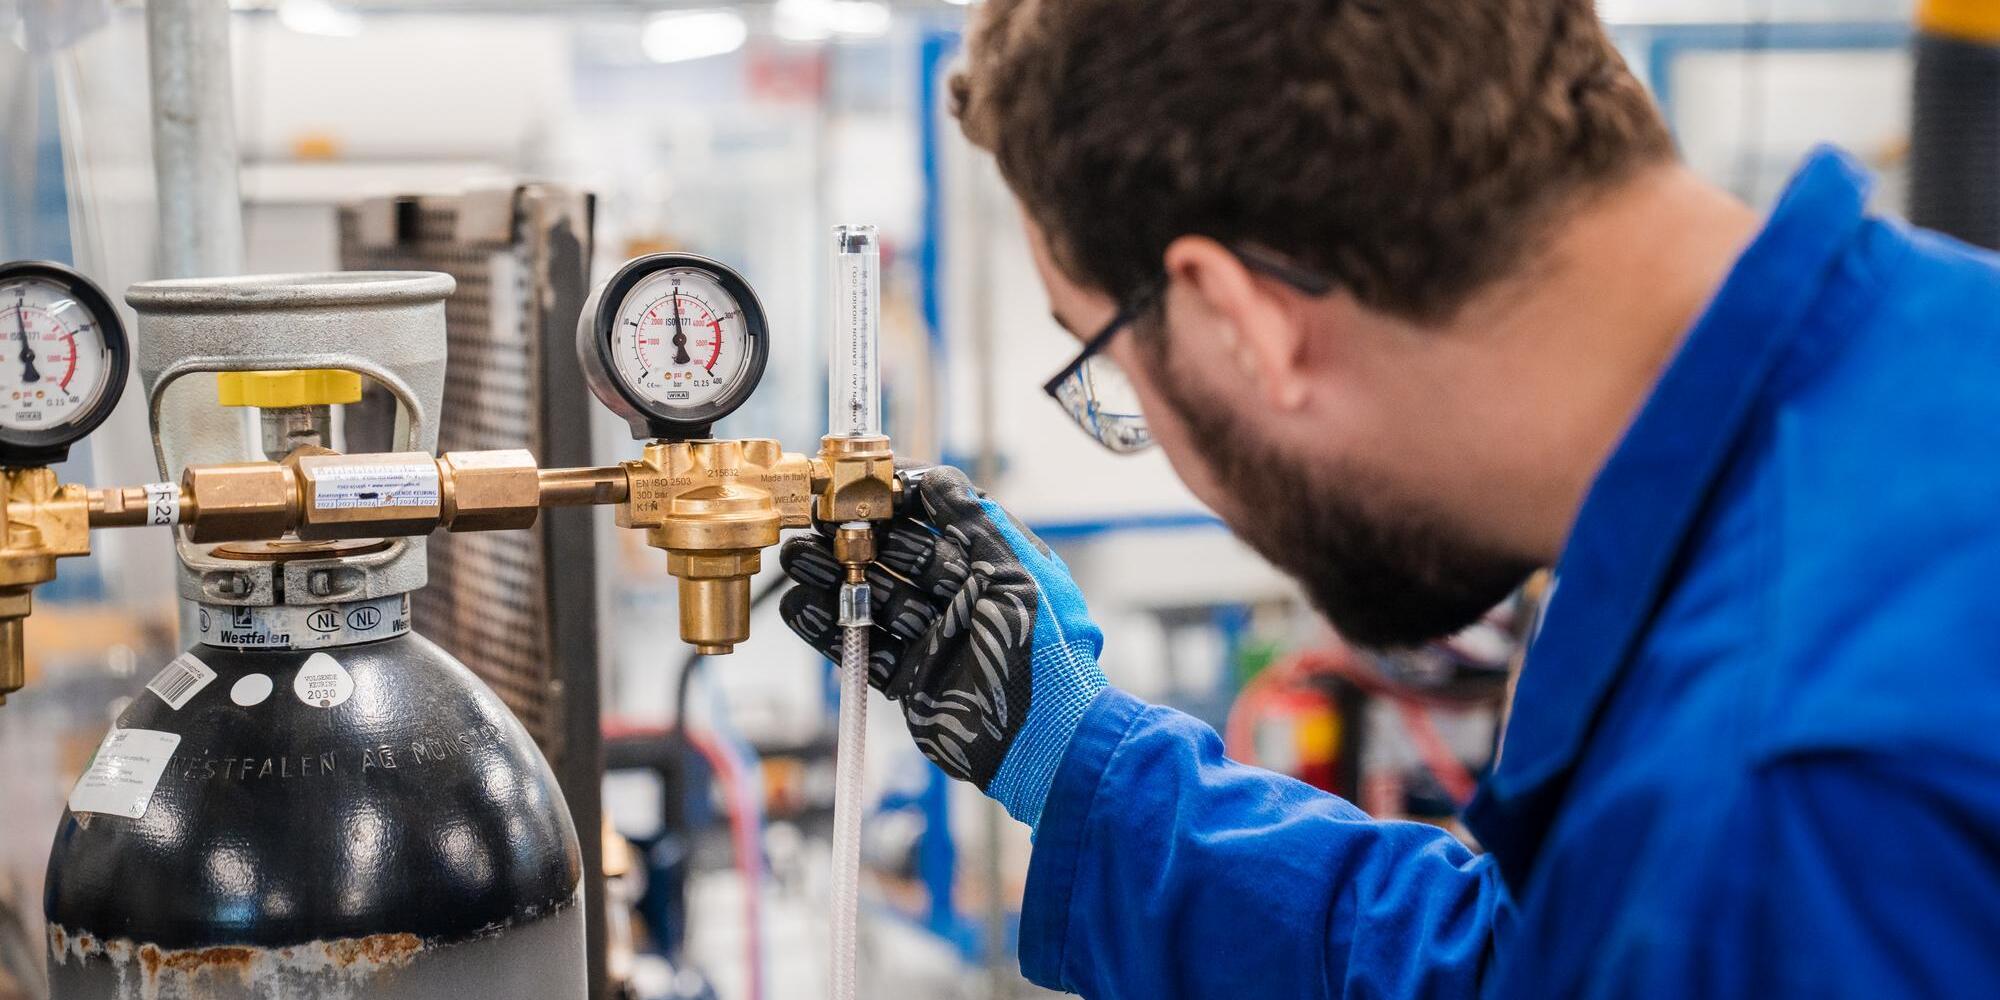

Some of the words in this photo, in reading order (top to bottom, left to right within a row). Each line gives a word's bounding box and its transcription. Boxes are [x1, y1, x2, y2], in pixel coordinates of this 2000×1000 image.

[636, 479, 649, 488] EN
[651, 478, 668, 487] ISO
[670, 477, 692, 487] 2503
[760, 473, 782, 482] Made
[791, 472, 808, 481] Italy
[636, 490, 652, 499] 300
[654, 490, 668, 499] bar
[317, 613, 340, 629] NL
[356, 611, 375, 627] NL
[220, 630, 290, 645] Westfalen
[307, 689, 336, 700] 2030
[169, 751, 337, 781] WESTFALEN
[362, 744, 397, 772] AG
